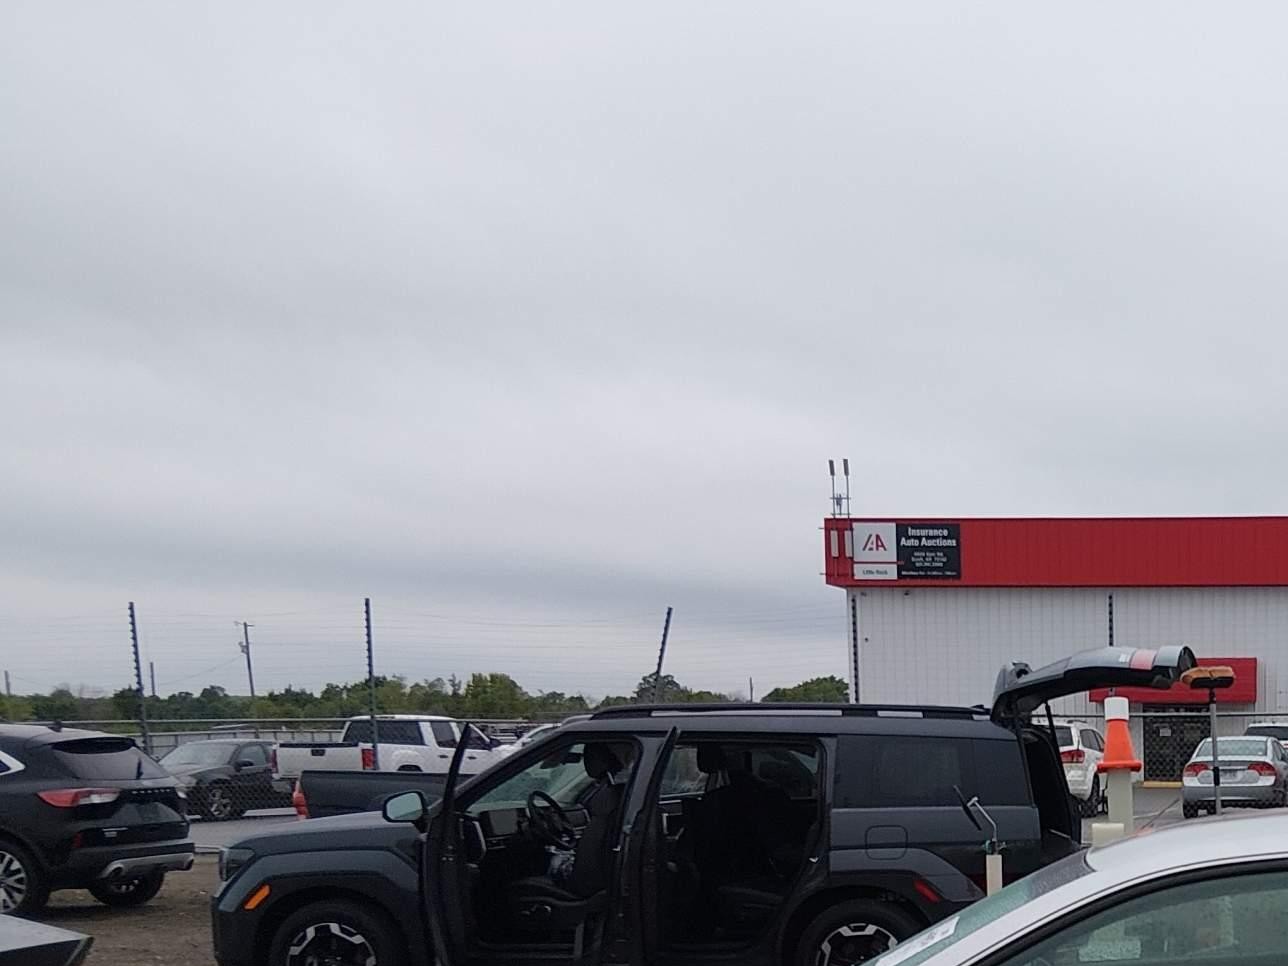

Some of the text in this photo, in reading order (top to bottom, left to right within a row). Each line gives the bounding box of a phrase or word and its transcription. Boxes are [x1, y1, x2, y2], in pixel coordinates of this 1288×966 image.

[908, 526, 949, 537] Insurance
[900, 537, 957, 547] Auto Auctions
